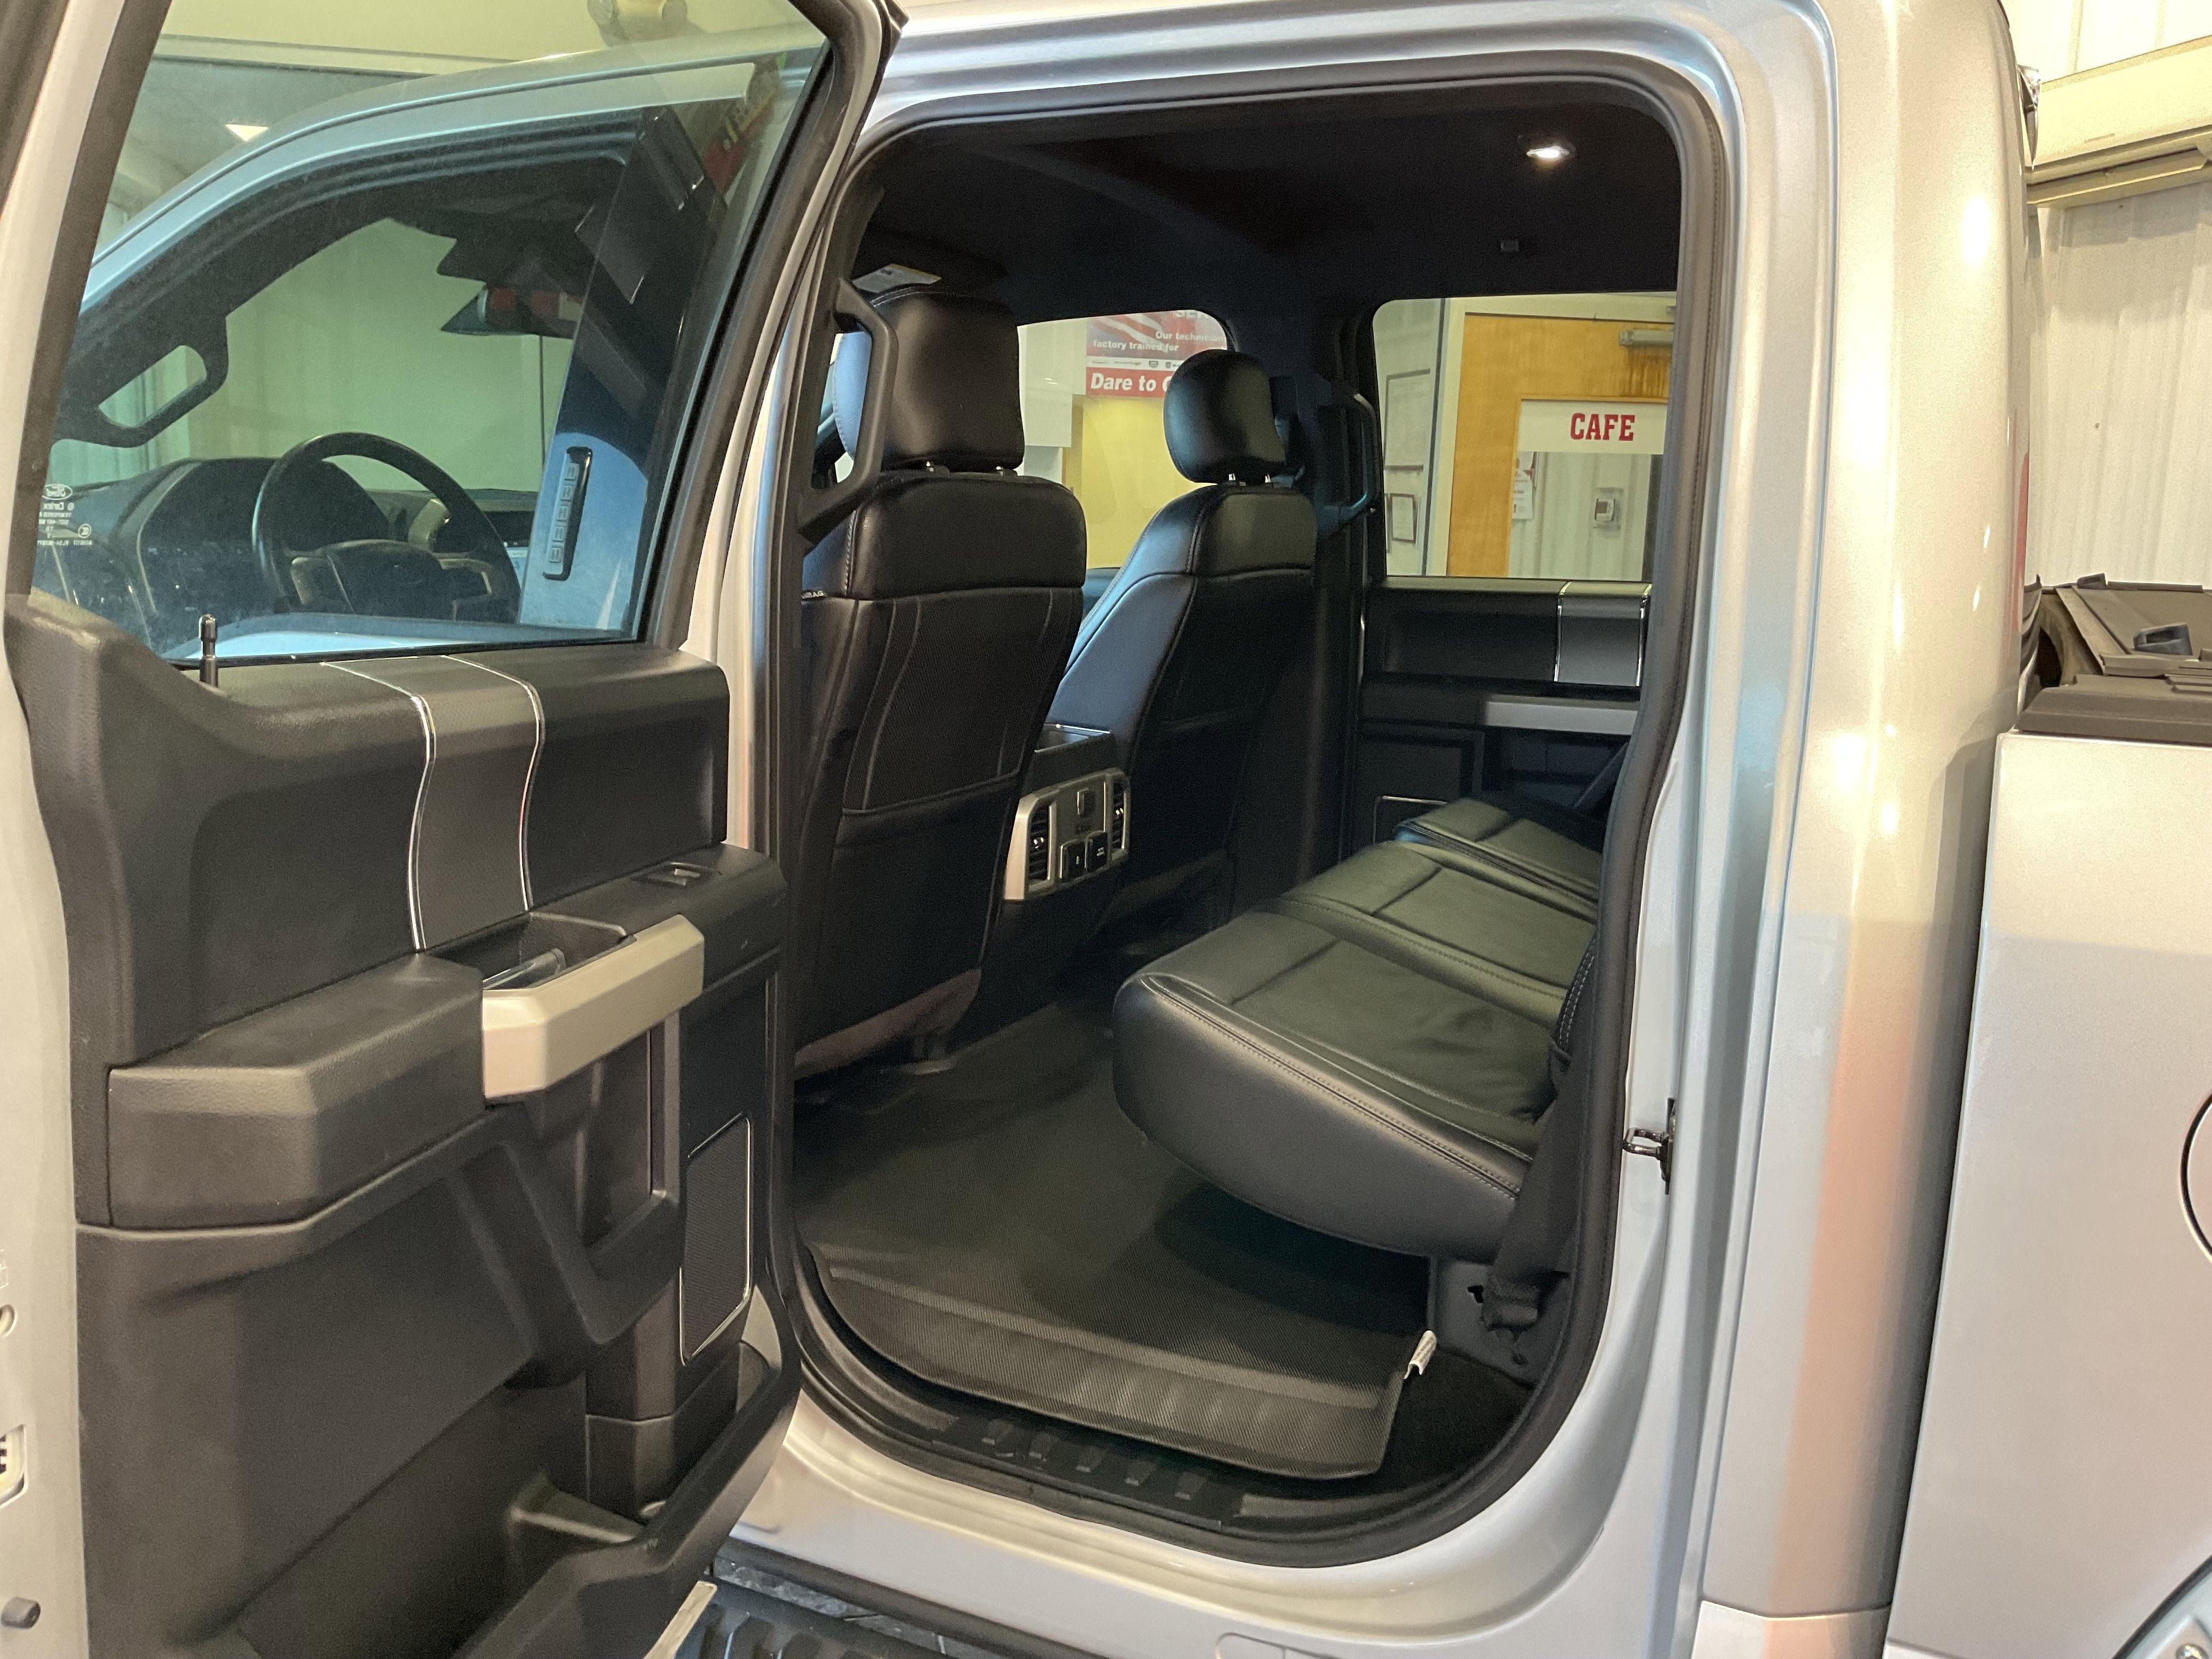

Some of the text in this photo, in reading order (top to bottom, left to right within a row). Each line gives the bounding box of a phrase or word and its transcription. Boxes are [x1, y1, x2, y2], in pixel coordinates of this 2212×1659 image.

[1155, 331, 1173, 339] Our
[1093, 340, 1179, 353] factory trained for
[1091, 373, 1133, 391] Dare
[1138, 375, 1156, 392] to
[1570, 413, 1635, 441] CAFE
